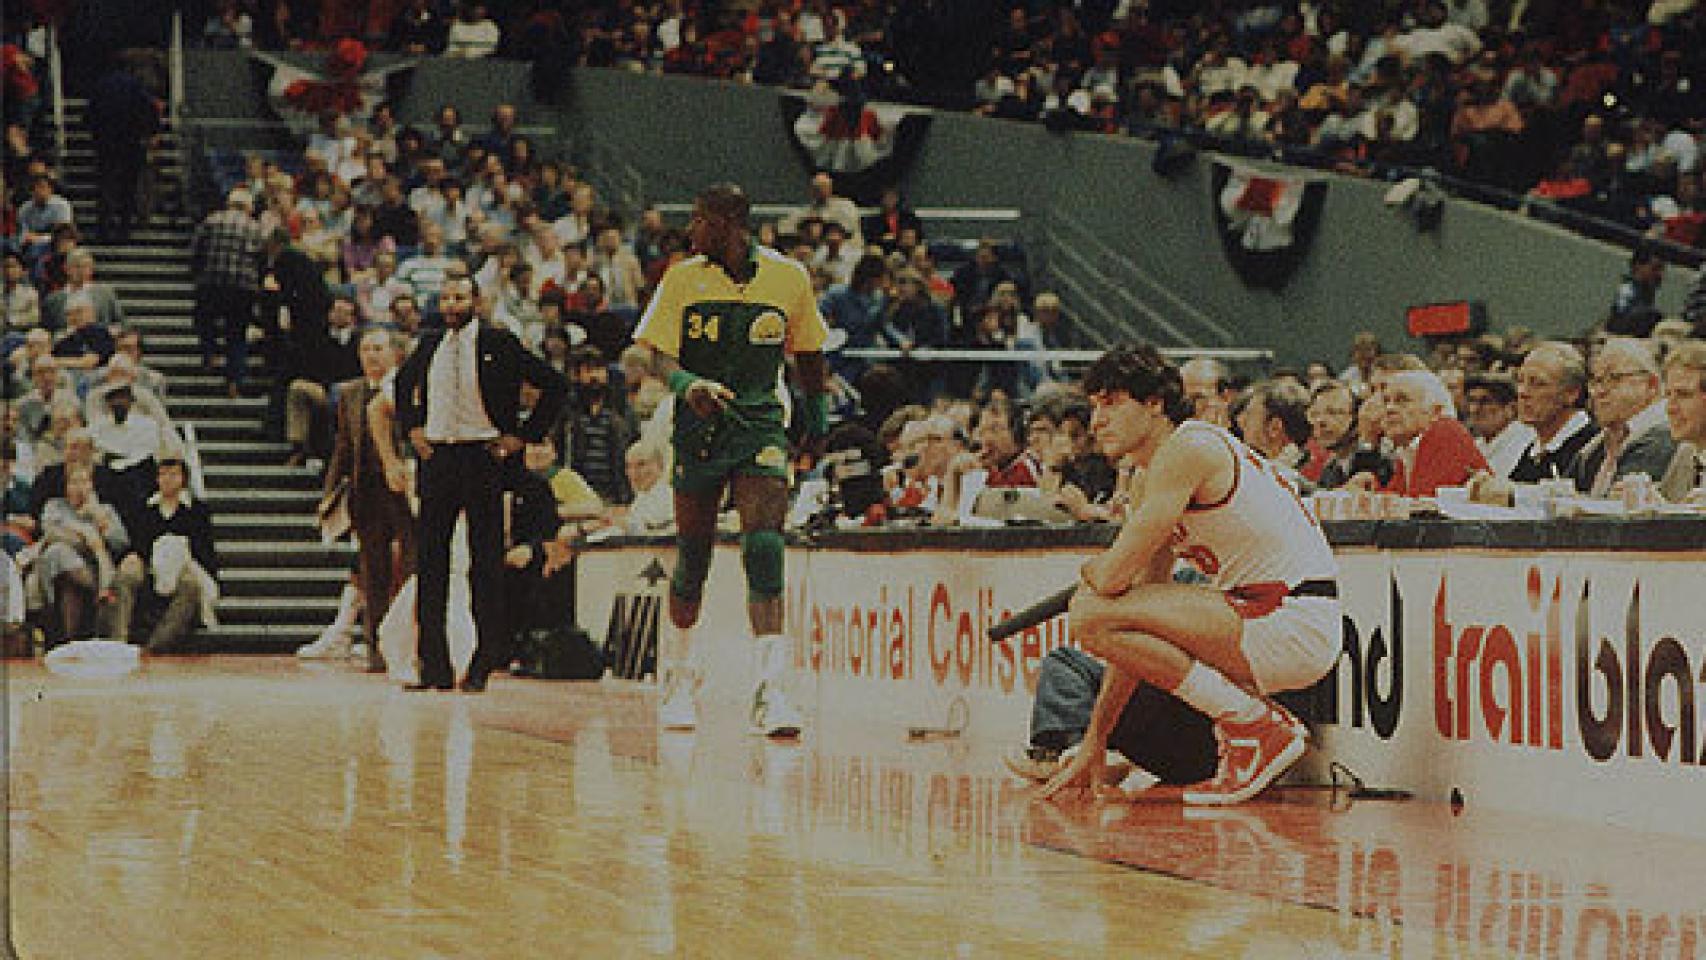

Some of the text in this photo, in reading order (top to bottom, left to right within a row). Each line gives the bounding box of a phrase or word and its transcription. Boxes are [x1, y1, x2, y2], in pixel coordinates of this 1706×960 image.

[688, 312, 720, 342] 34
[786, 576, 914, 681] Memorial
[1433, 566, 1563, 750] trail
[1573, 577, 1706, 764] bla
